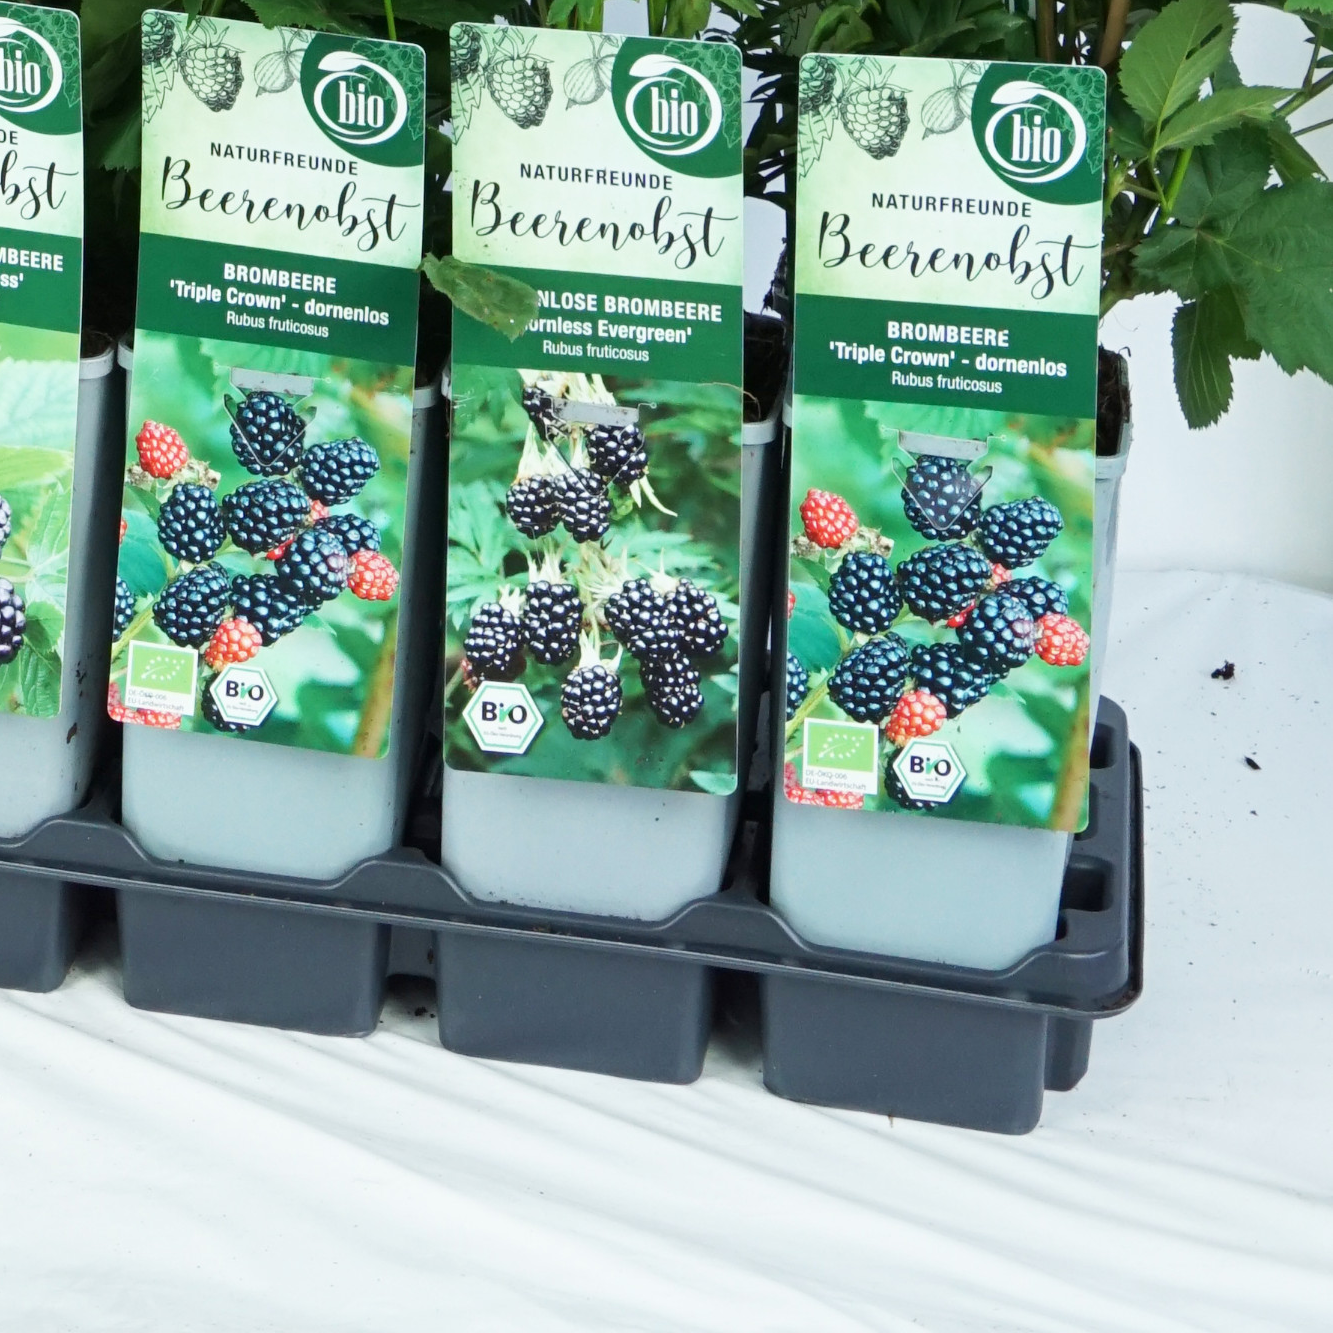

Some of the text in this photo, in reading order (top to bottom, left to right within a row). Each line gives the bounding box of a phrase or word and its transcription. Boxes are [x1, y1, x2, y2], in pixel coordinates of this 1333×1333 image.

[338, 80, 385, 128] bio
[650, 86, 698, 136] bio
[1011, 114, 1062, 163] bio
[210, 142, 359, 176] NATURFREUNDE
[520, 162, 673, 191] NATURFREUNDE
[161, 155, 421, 251] Beerenobst
[871, 193, 1032, 218] NATURFREUNDE
[471, 179, 738, 269] Beerenobst
[818, 211, 1099, 300] Beerenobst
[223, 262, 336, 295] BROMBEERE
[170, 279, 222, 305] 'Triple
[226, 287, 286, 311] Crown'
[304, 298, 389, 326] dornenlos
[537, 290, 722, 322] NLOSE BROMBEERE
[226, 310, 329, 338] Rubus fruticosus
[525, 317, 692, 344] ornless Evergreen'
[887, 321, 1009, 347] BROMBEERE
[543, 340, 650, 362] Rubus fruticosus
[829, 341, 886, 364] 'Triple
[890, 345, 955, 368] Crown'
[975, 353, 1067, 377] dornenlos
[892, 371, 1002, 393] Rubus fruticosus
